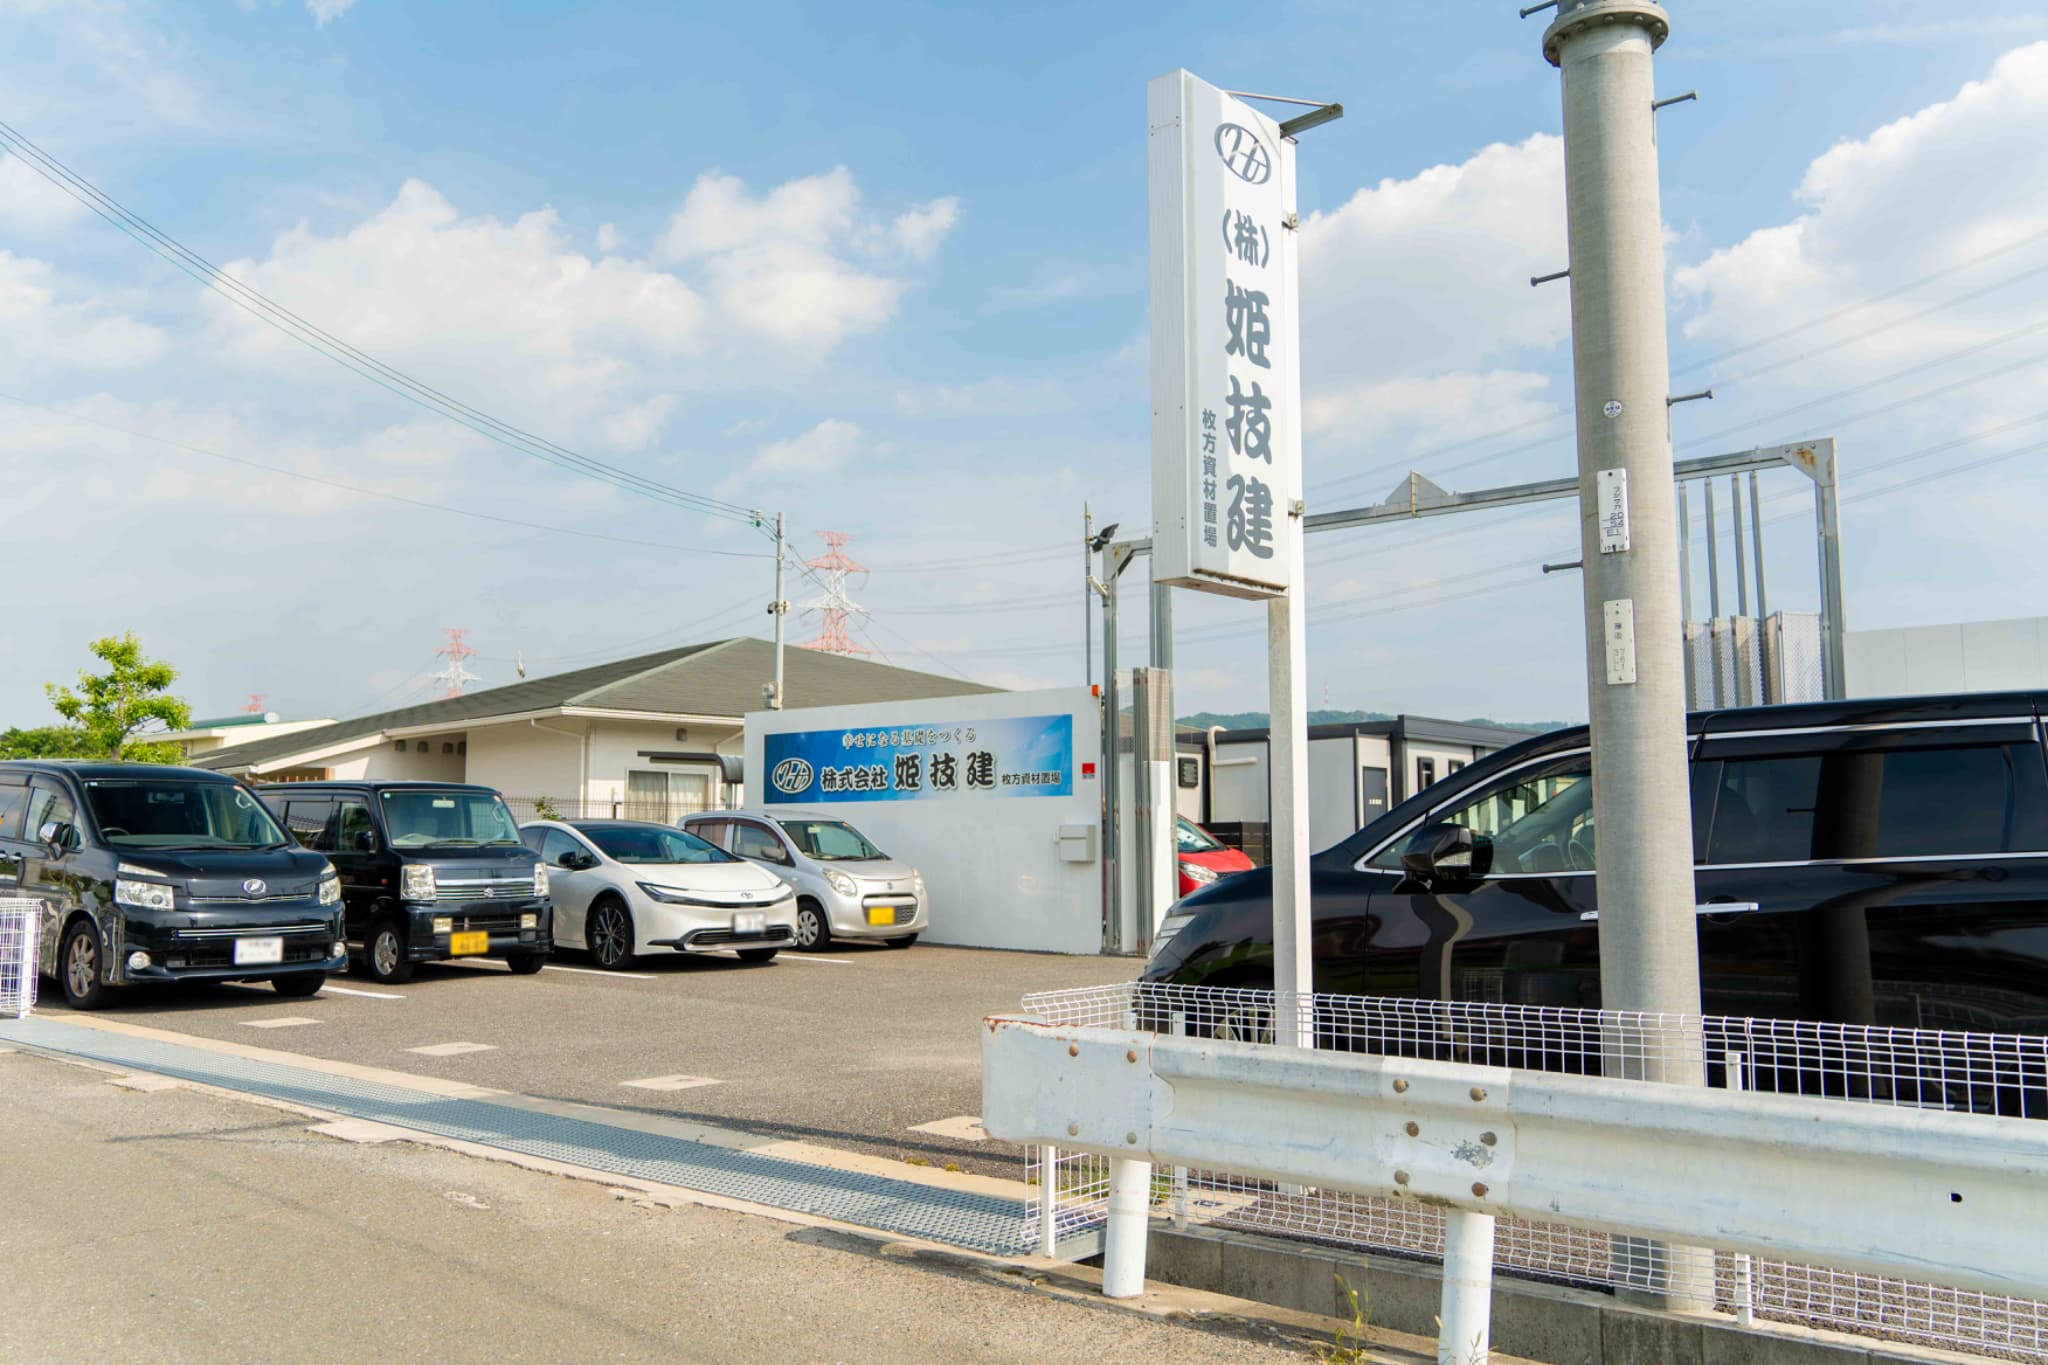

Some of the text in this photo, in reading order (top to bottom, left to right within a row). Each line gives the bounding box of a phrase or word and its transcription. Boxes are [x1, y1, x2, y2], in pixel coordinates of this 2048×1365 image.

[1201, 407, 1218, 548] 枚方資材置場
[842, 727, 977, 749] 幸せになる基礎をつくる
[1001, 771, 1062, 786] 枚方資材置場
